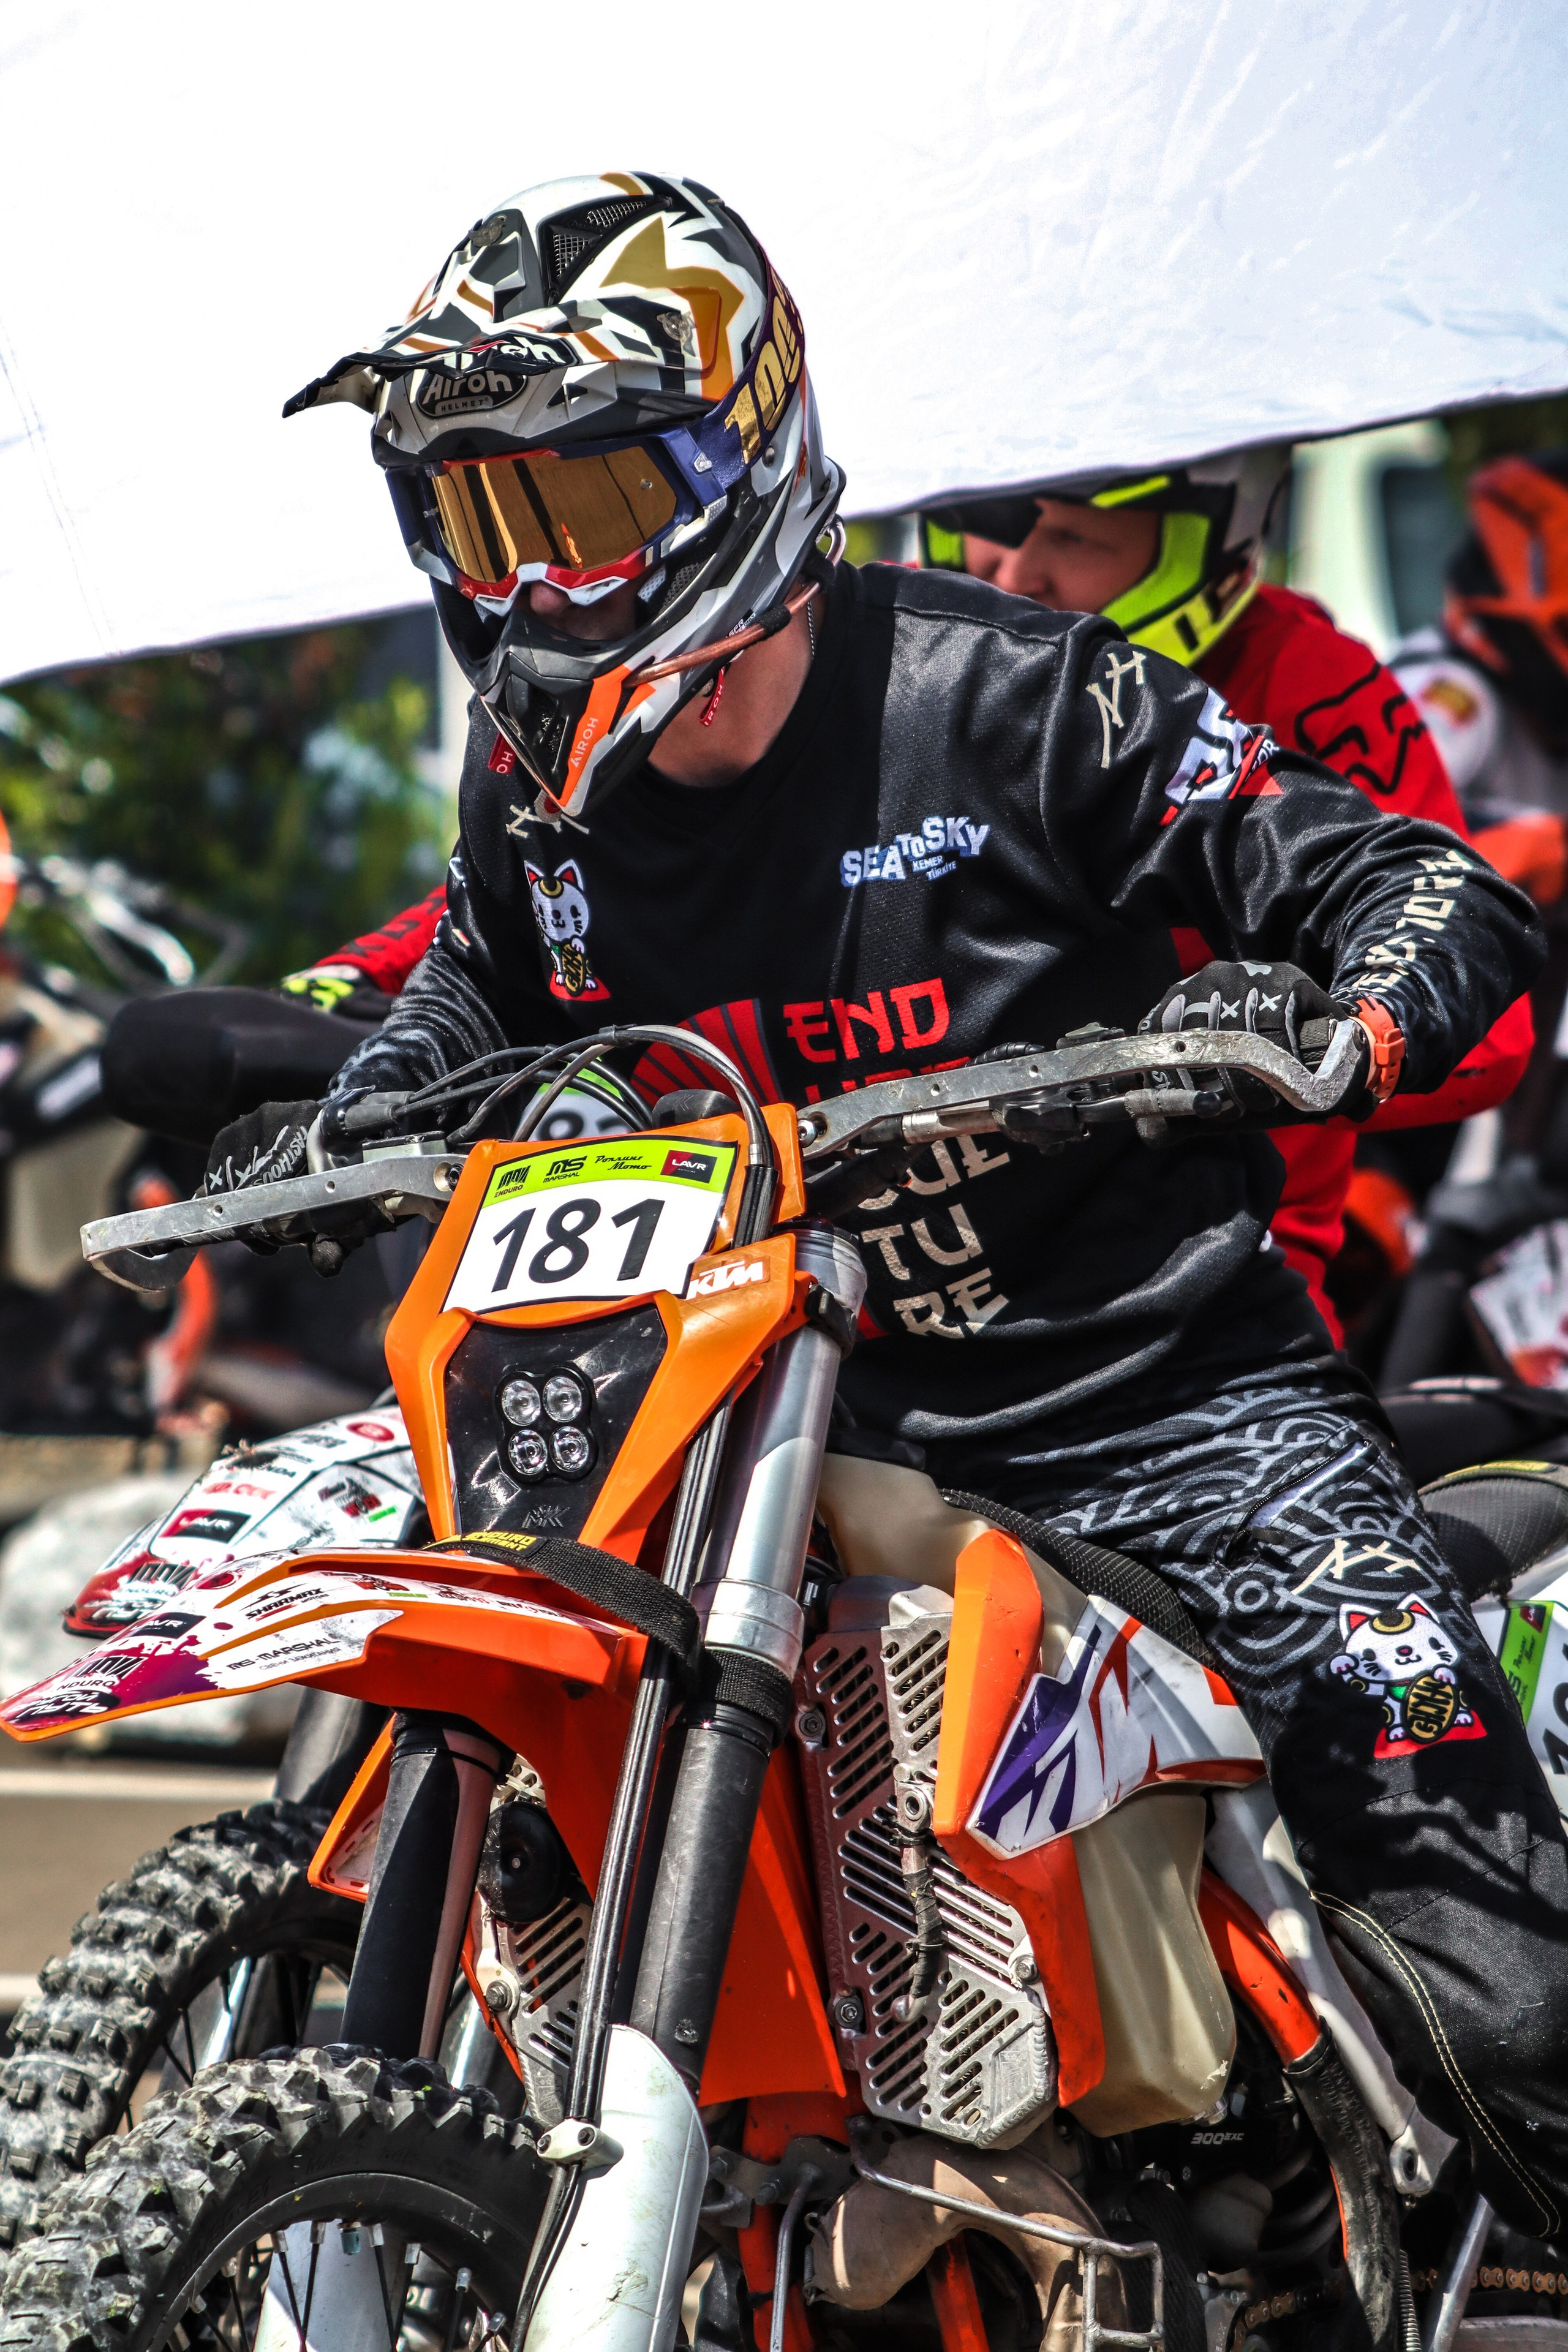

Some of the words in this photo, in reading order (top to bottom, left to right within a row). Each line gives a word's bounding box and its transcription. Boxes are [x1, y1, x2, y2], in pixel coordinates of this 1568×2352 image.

[440, 400, 483, 412] HELMET
[570, 717, 598, 768] AIROH
[840, 845, 907, 887] SEA
[922, 815, 990, 856] SKY
[911, 856, 943, 872] KEMER
[783, 978, 950, 1063] END
[543, 1172, 580, 1183] MARSHAL
[671, 1159, 707, 1171] LAVR
[494, 1184, 524, 1198] ENDURO
[491, 1198, 666, 1293] 181
[861, 1203, 984, 1281] TU
[684, 1260, 764, 1301] KTM
[892, 1267, 1011, 1339] RE
[245, 1588, 325, 1620] SHARMAX
[130, 1619, 184, 1631] LAVR
